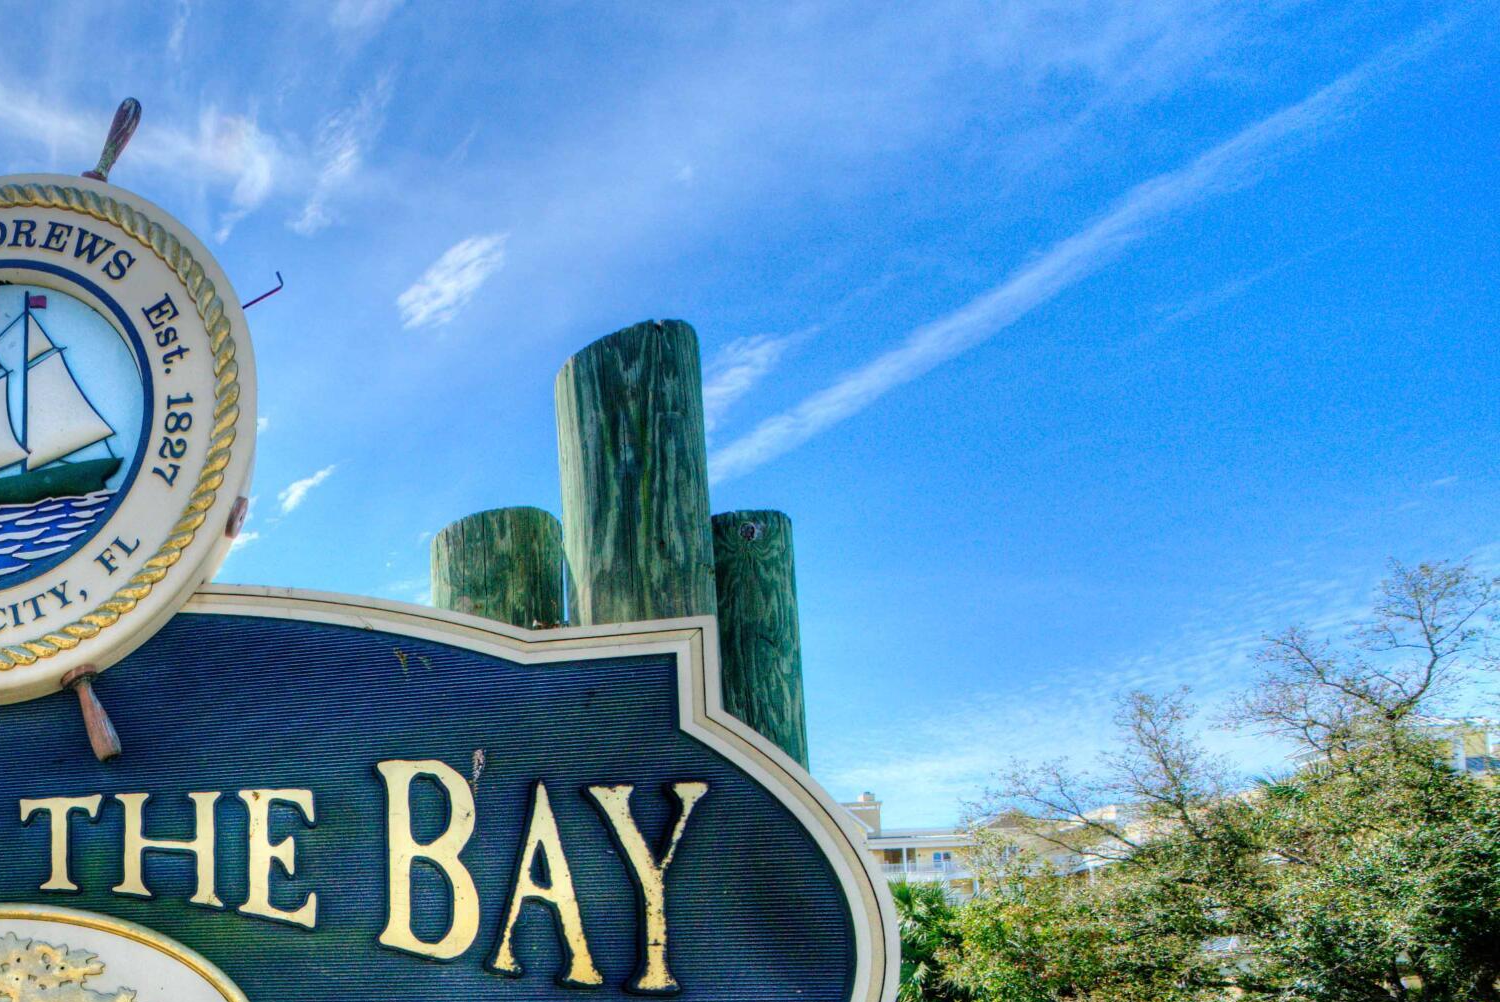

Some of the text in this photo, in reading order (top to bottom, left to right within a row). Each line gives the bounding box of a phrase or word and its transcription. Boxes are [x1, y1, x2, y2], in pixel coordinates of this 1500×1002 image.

[141, 292, 194, 488] Est. 1827
[94, 534, 142, 577] FL
[19, 788, 317, 929] THE
[376, 758, 710, 992] BAY
